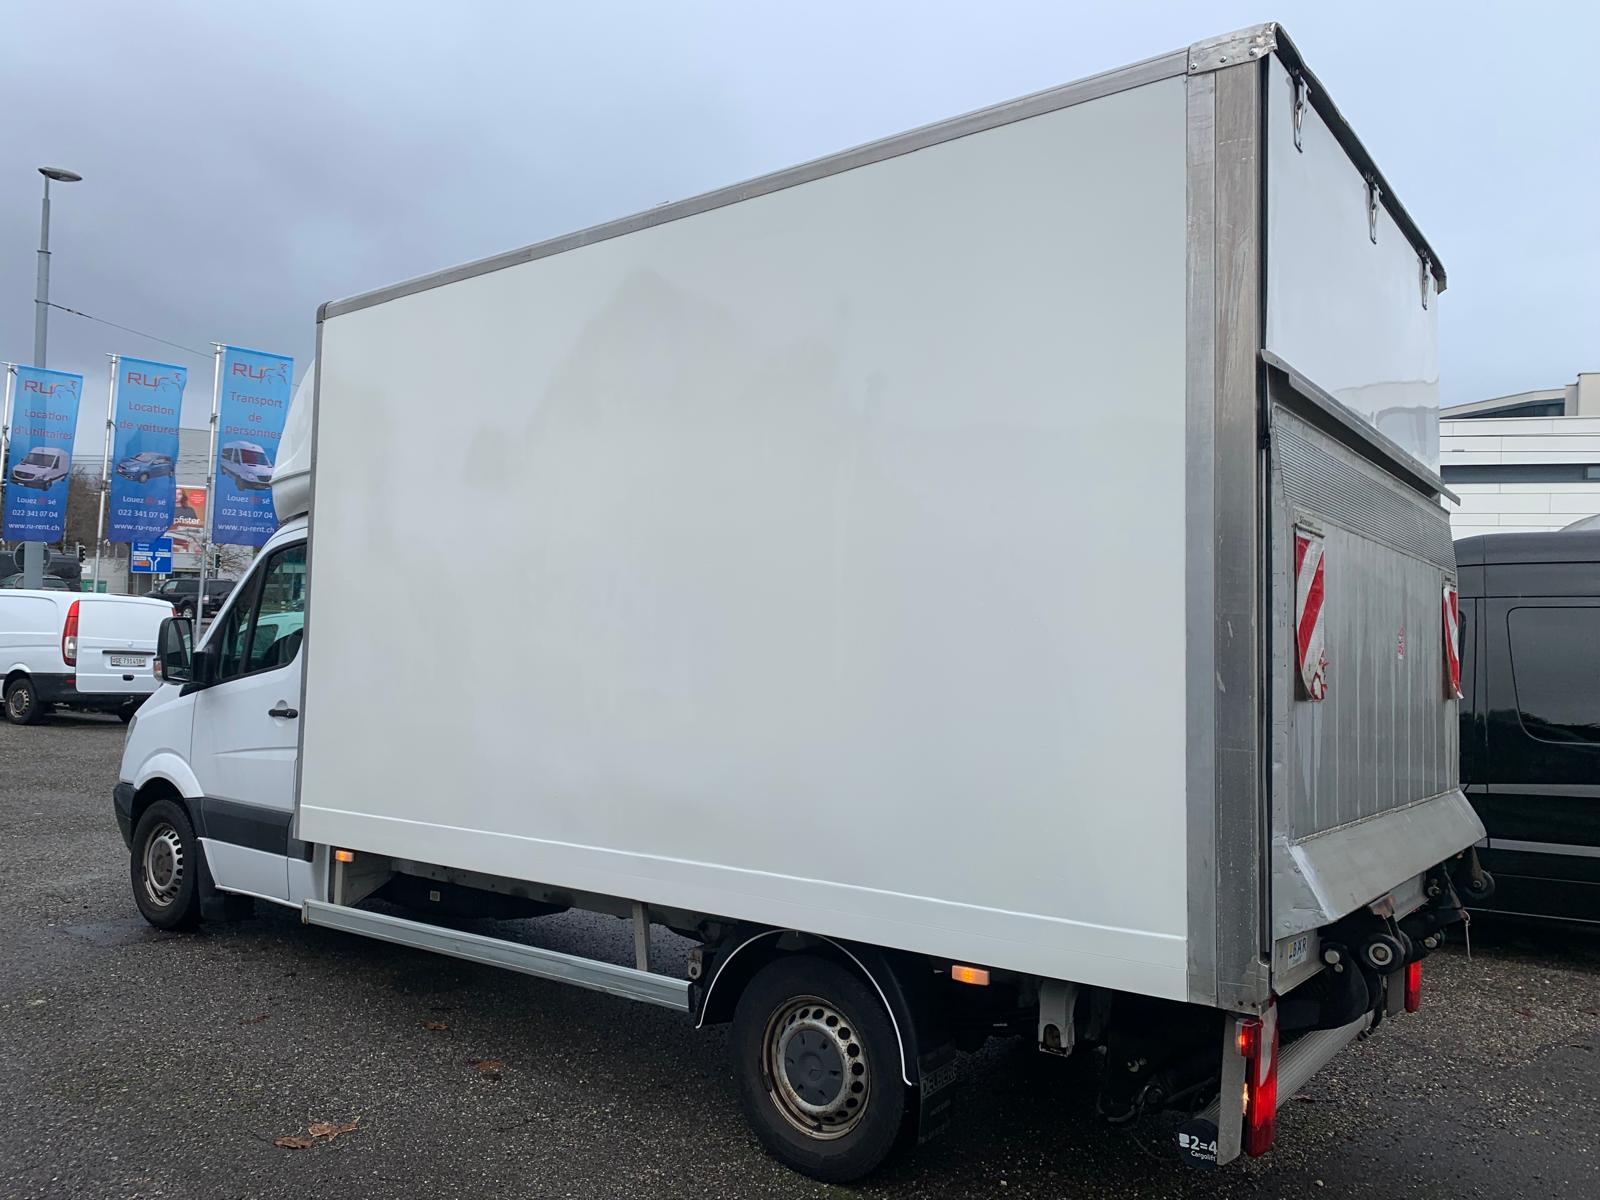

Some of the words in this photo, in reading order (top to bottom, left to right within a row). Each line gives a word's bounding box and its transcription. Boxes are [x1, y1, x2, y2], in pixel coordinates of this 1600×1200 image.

[231, 392, 283, 408] Transport
[128, 401, 175, 415] Location
[24, 409, 68, 421] Location
[248, 412, 263, 423] de
[120, 421, 134, 430] de
[224, 425, 282, 440] personnes
[16, 496, 38, 505] Louez
[122, 496, 144, 504] Louez
[227, 494, 249, 503] Louez
[39, 510, 48, 518] 07
[48, 511, 59, 519] 04
[118, 509, 132, 517] 022
[134, 510, 148, 518] 341
[148, 511, 159, 519] 07
[222, 508, 237, 516] 022
[238, 510, 252, 518] 341
[263, 512, 274, 520] 04
[173, 515, 201, 525] pfister
[8, 522, 61, 532] www.ru-rent.ch
[217, 523, 275, 534] www.ru-rent.ch
[1190, 1135, 1217, 1155] 2=4
[1190, 1150, 1216, 1162] Cargolift
